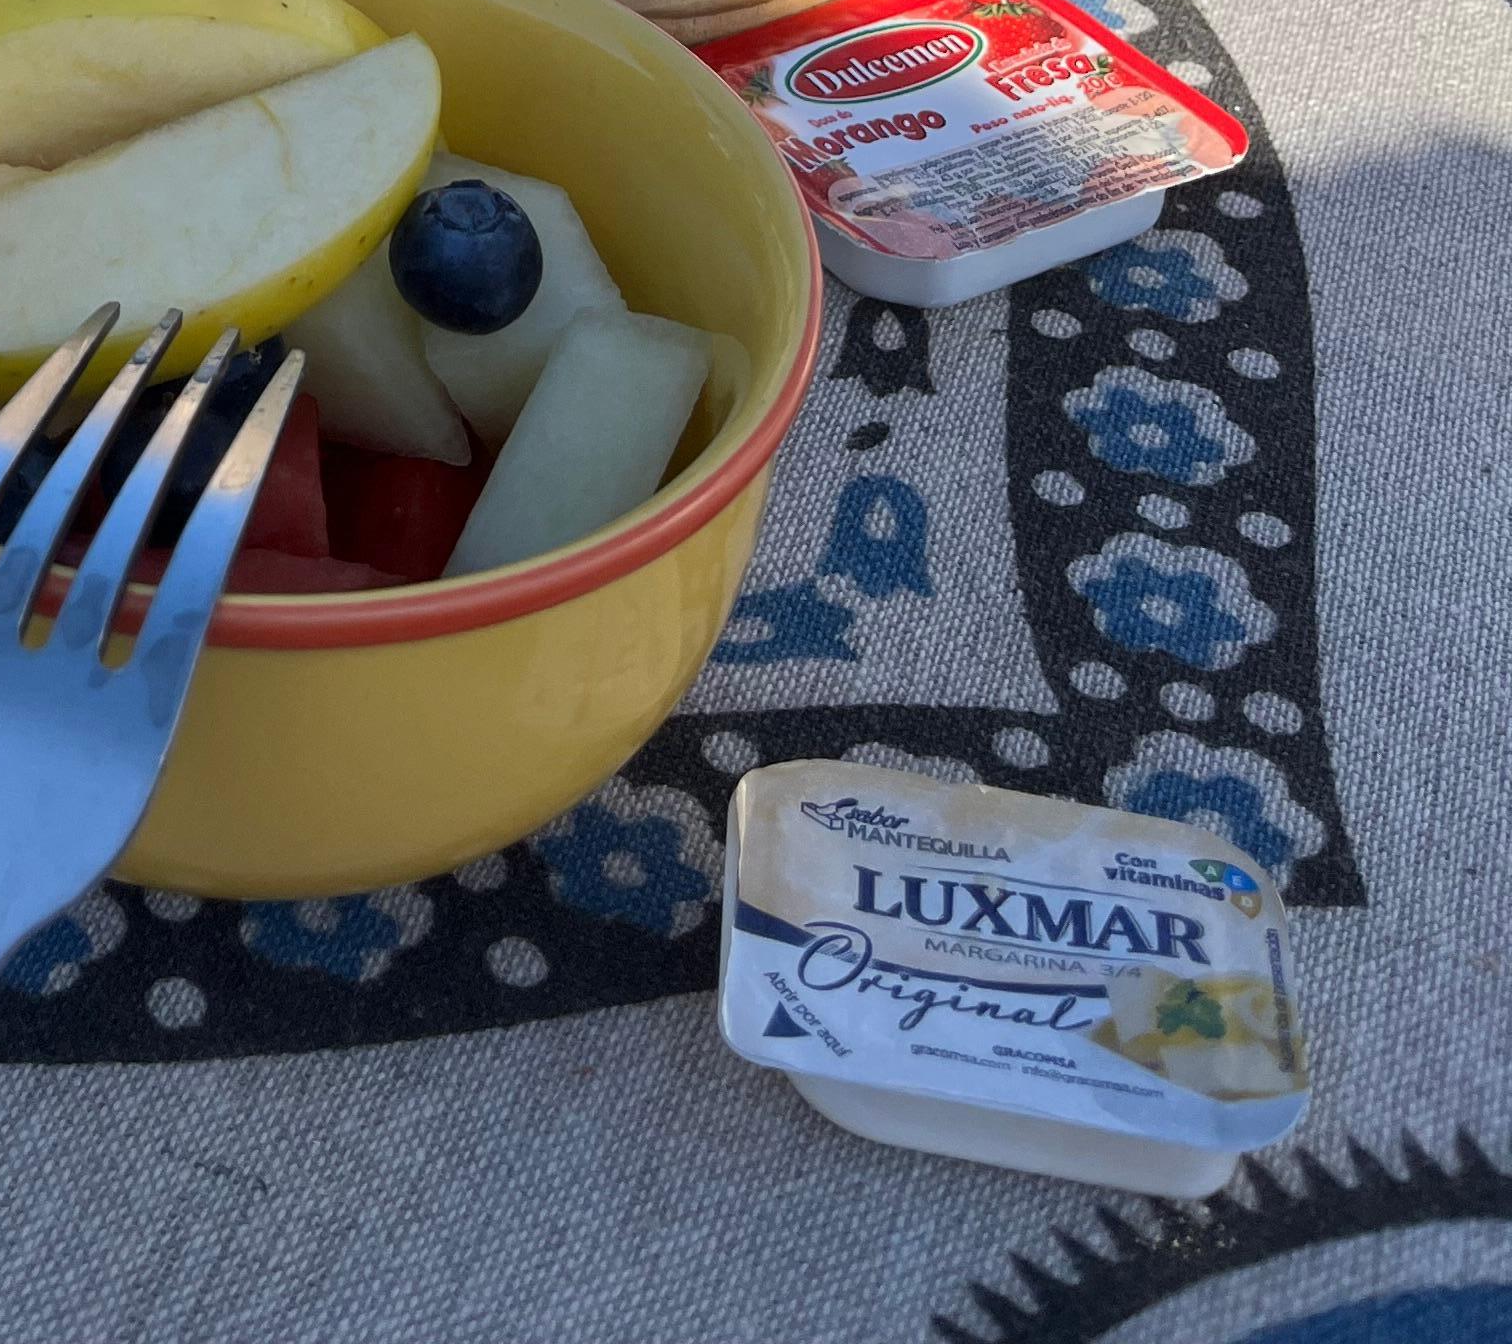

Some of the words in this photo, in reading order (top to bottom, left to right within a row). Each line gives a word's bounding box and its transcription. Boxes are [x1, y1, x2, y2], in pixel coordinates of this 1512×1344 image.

[804, 33, 970, 96] Dulcemen
[984, 52, 1098, 102] Fresa
[778, 110, 948, 172] Morango
[969, 116, 1009, 134] Peso
[847, 821, 1012, 863] MANTEQUILLA
[1114, 852, 1157, 869] Con
[1103, 865, 1226, 902] vitaminas
[852, 864, 1211, 965] LUXMAR
[797, 921, 1094, 1031] Original
[924, 937, 1088, 975] MARGARINA
[1100, 962, 1143, 979] 3/4
[763, 971, 800, 1002] Abrir
[792, 1003, 822, 1026] por
